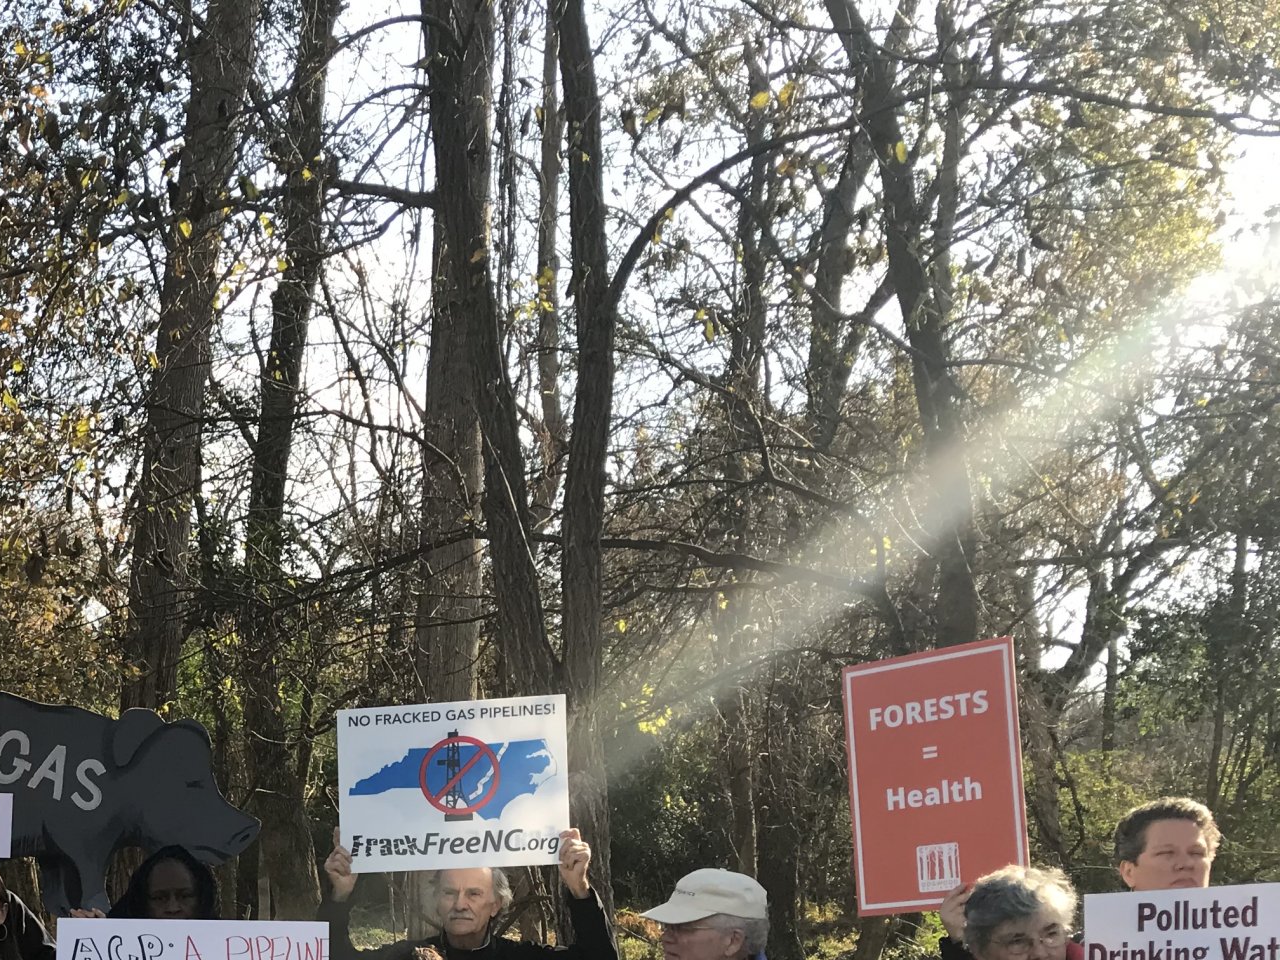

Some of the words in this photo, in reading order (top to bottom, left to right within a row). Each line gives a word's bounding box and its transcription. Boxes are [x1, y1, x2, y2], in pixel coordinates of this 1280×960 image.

[348, 715, 371, 727] NO
[375, 711, 441, 726] FRACKED
[447, 708, 475, 721] GAS
[480, 703, 556, 719] PIPELINES!
[869, 690, 989, 731] FORESTS
[886, 777, 982, 811] Health
[351, 829, 560, 857] FrackFreeNC.org
[1137, 896, 1258, 932] Polluted
